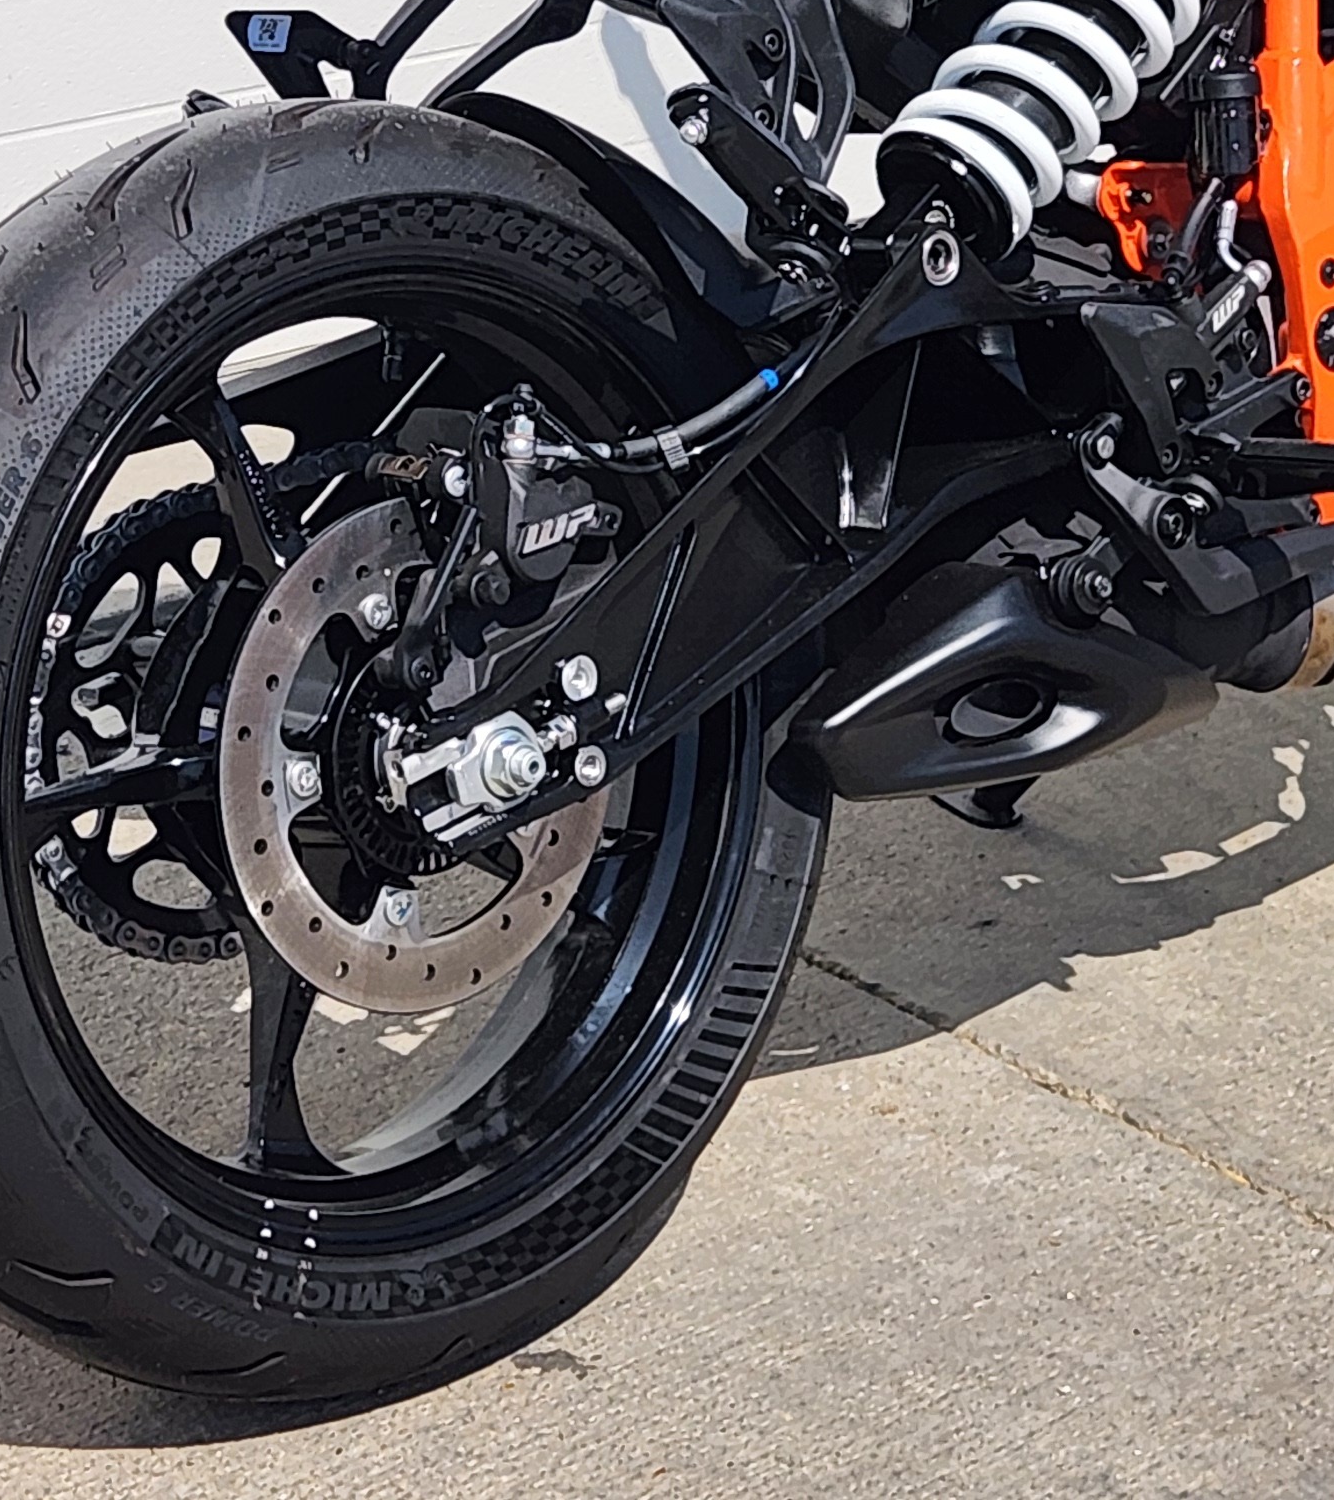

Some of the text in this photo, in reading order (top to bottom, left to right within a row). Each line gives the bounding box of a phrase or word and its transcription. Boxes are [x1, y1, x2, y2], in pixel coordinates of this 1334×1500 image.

[432, 202, 653, 308] MICHELIN
[1212, 284, 1246, 333] WP
[20, 430, 43, 465] 6
[522, 503, 596, 555] WP
[172, 1231, 392, 1312] MICHELIN
